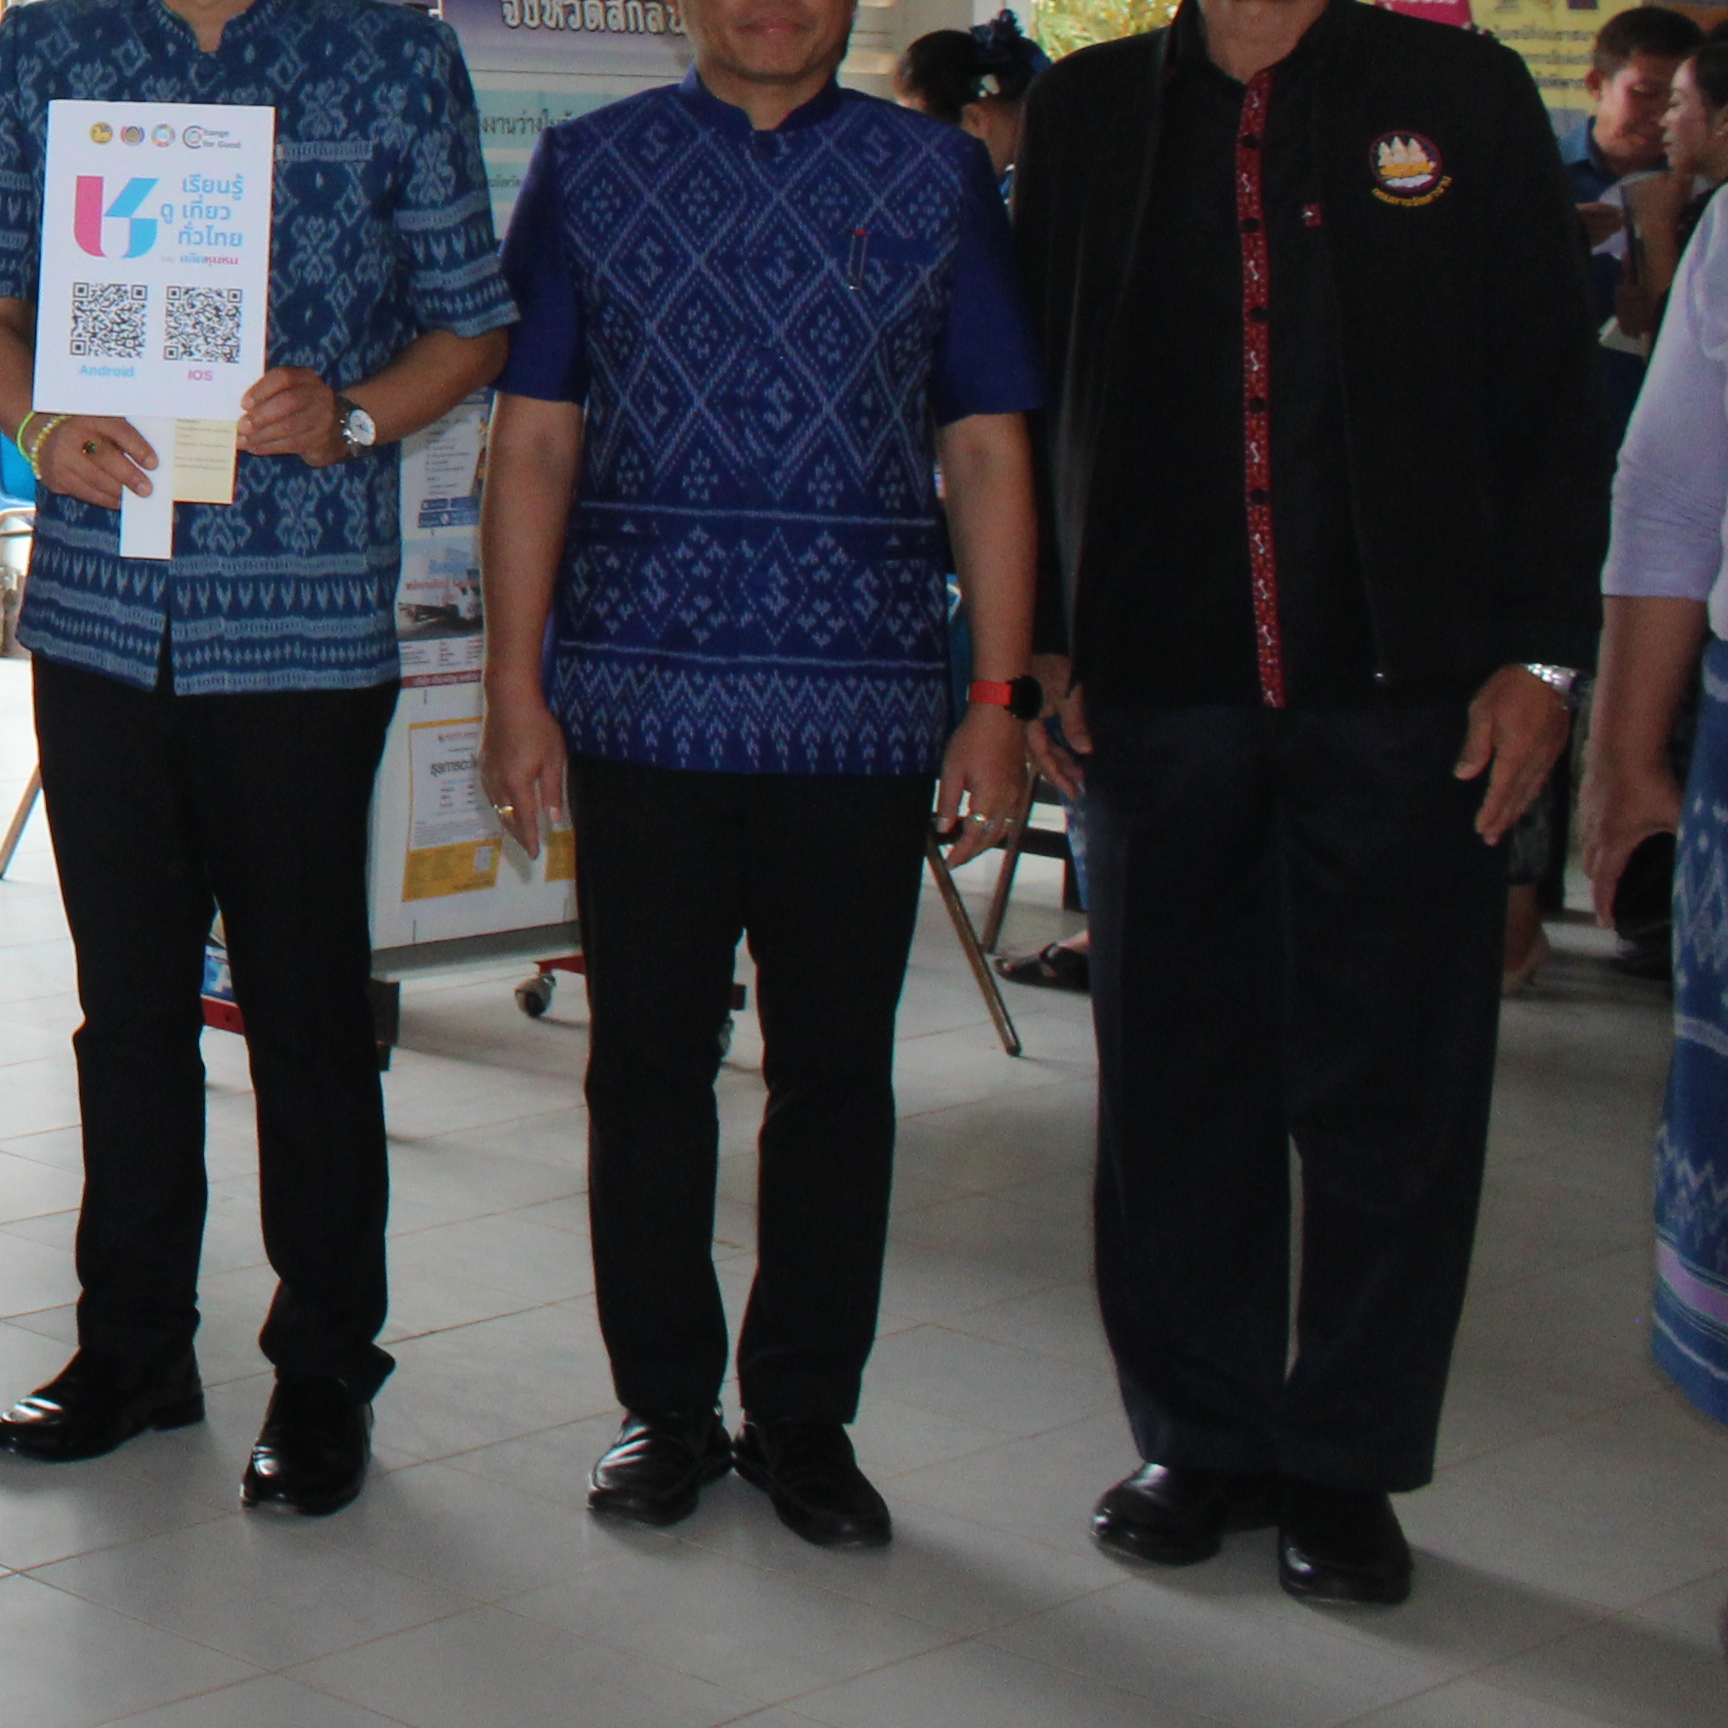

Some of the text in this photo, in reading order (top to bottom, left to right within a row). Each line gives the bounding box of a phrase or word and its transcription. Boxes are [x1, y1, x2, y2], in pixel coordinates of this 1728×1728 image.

[182, 173, 243, 201] เรียนรู้
[160, 195, 231, 224] ดู เที่ยว
[178, 222, 243, 248] ทั่วไทย
[79, 365, 136, 378] Android
